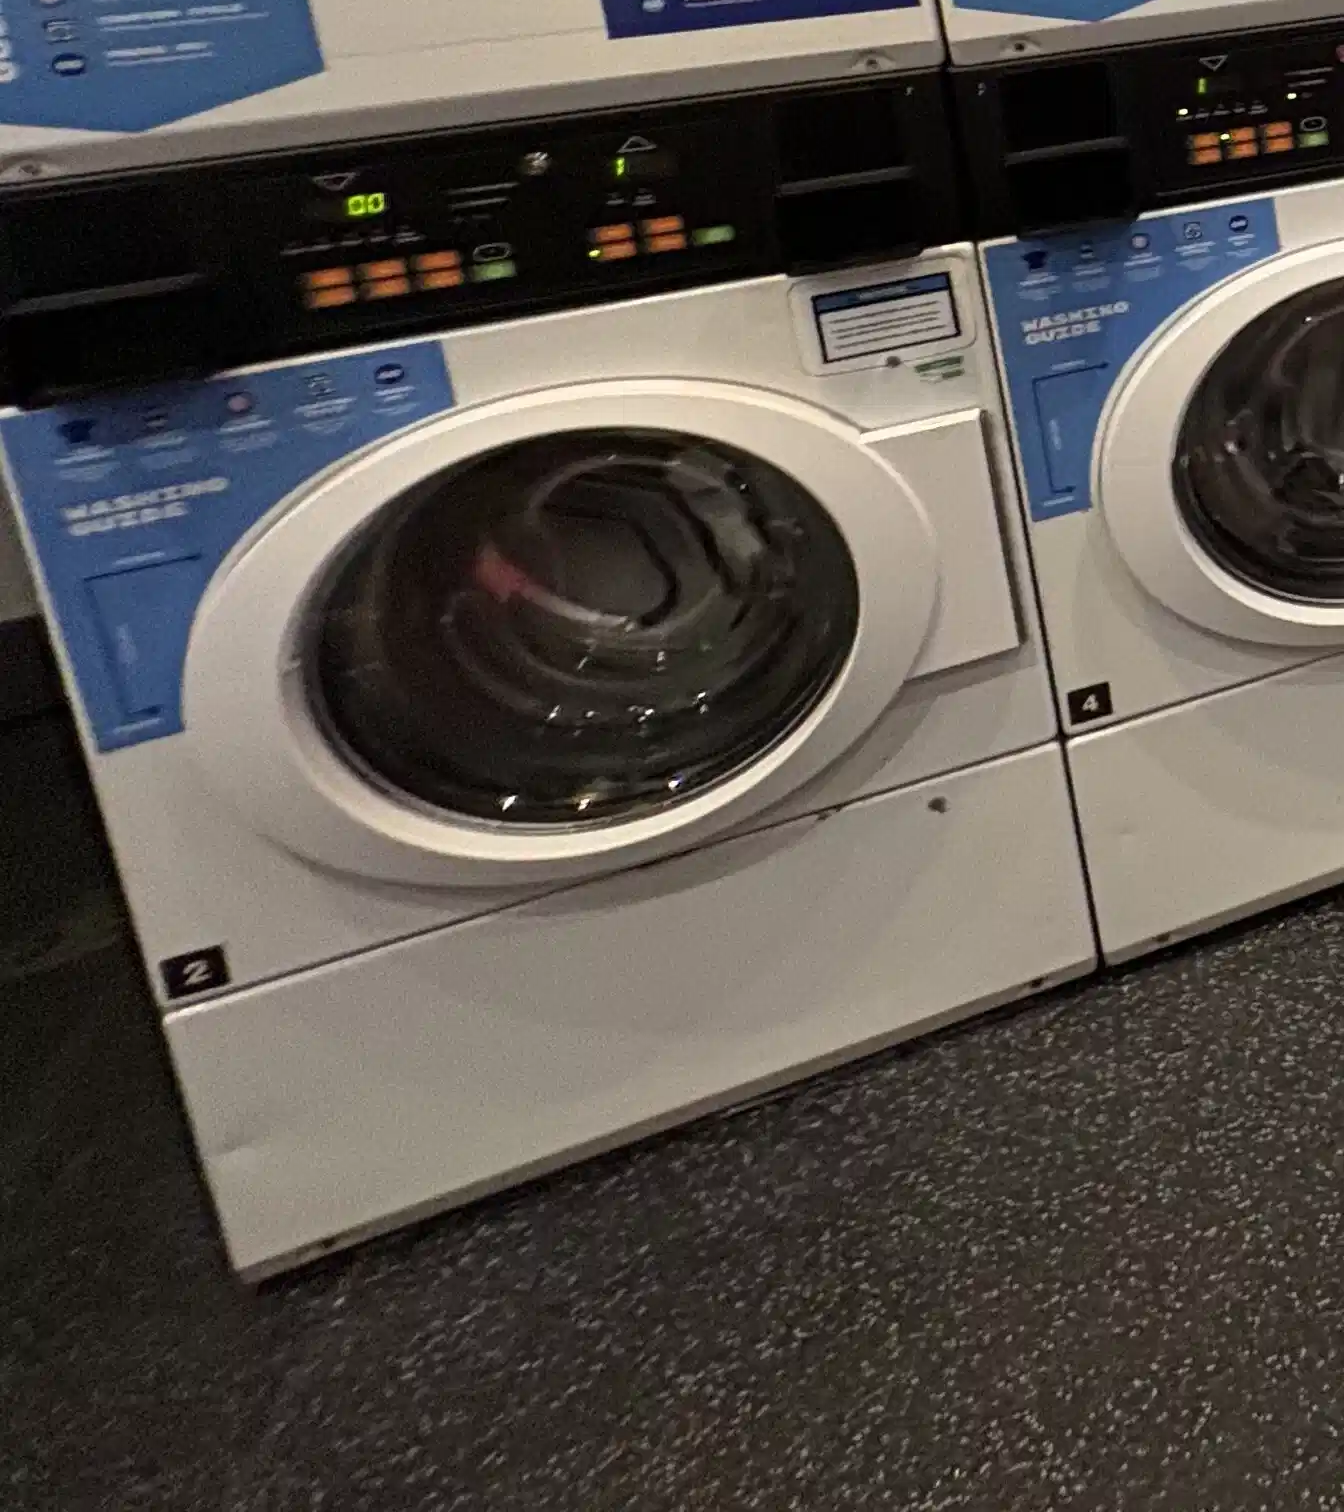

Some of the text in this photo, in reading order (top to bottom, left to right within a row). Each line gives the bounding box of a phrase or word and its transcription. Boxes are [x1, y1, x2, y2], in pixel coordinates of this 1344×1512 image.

[1020, 299, 1132, 334] WASHING
[1024, 319, 1103, 347] GUIDE
[1081, 693, 1101, 712] 4
[182, 959, 214, 986] 2
